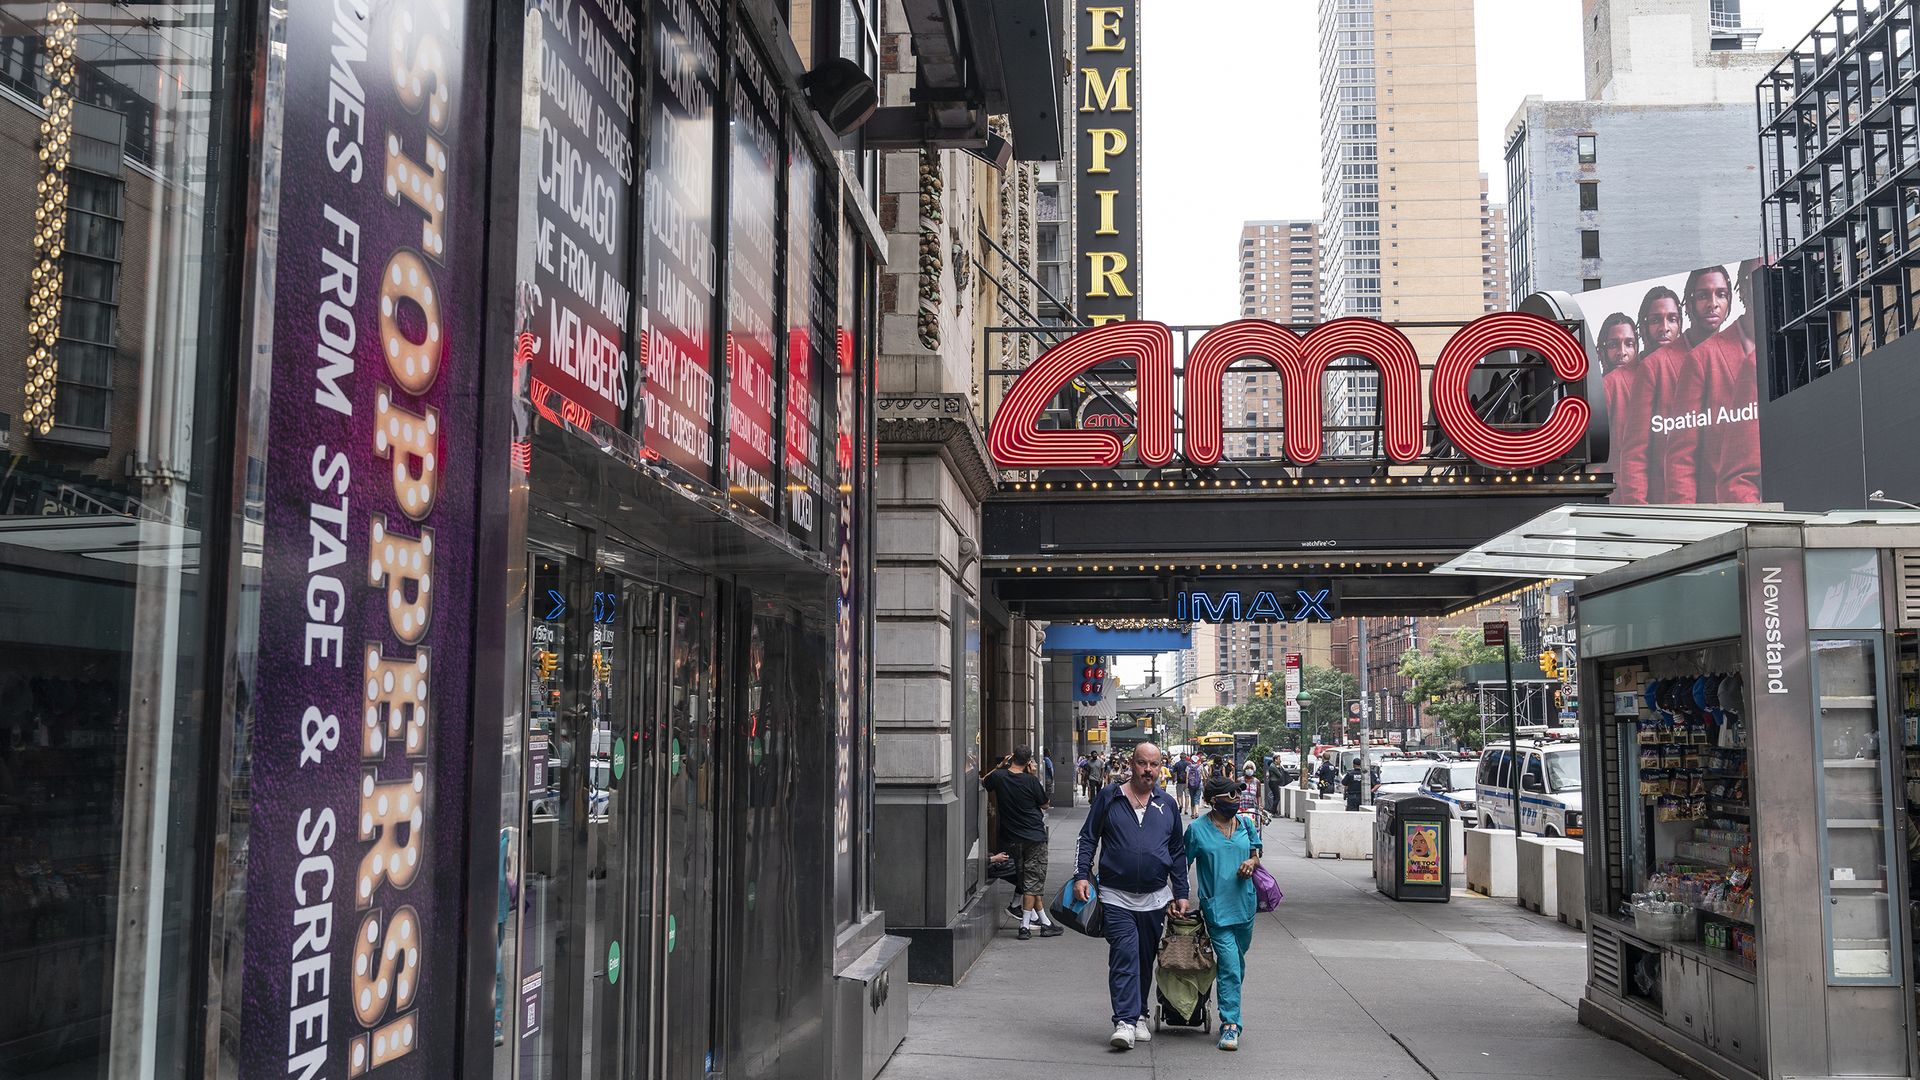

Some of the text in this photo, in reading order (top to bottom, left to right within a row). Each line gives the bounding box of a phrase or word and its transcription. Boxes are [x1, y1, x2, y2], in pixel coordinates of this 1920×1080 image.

[579, 5, 634, 124] PANTHER
[660, 21, 710, 126] DICKINSON
[694, 16, 719, 91] HANSEN
[763, 74, 780, 130] OPERA
[597, 105, 633, 186] BARES
[661, 102, 705, 217] FROZEN
[756, 114, 780, 182] GRAHAM
[1079, 6, 1133, 326] EMPIR
[539, 116, 616, 255] CHICAGO
[560, 232, 597, 307] FROM
[600, 270, 630, 333] AWAY
[690, 221, 717, 297] CHILD
[315, 204, 360, 416] FROM
[657, 258, 704, 350] HAMILTON
[549, 297, 629, 411] MEMBERS
[680, 350, 715, 426] POTTER
[737, 343, 754, 398] TIME
[756, 363, 765, 408] TO
[767, 374, 777, 419] DIE
[657, 398, 671, 440] THE
[673, 409, 697, 456] CURSED
[698, 427, 714, 467] CHILD
[751, 421, 767, 457] CRUISE
[767, 434, 777, 464] LINE
[1651, 402, 1759, 435] Spatial Audi
[736, 458, 748, 494] YORK
[750, 467, 759, 499] CITY
[759, 473, 776, 510] BALLET
[304, 444, 350, 668] STAGE
[1177, 589, 1333, 621] IMAX
[1761, 567, 1788, 694] Newsstand
[300, 706, 340, 768] &
[614, 753, 624, 766] Enter
[1520, 806, 1538, 827] YPD
[609, 956, 620, 972] Enter
